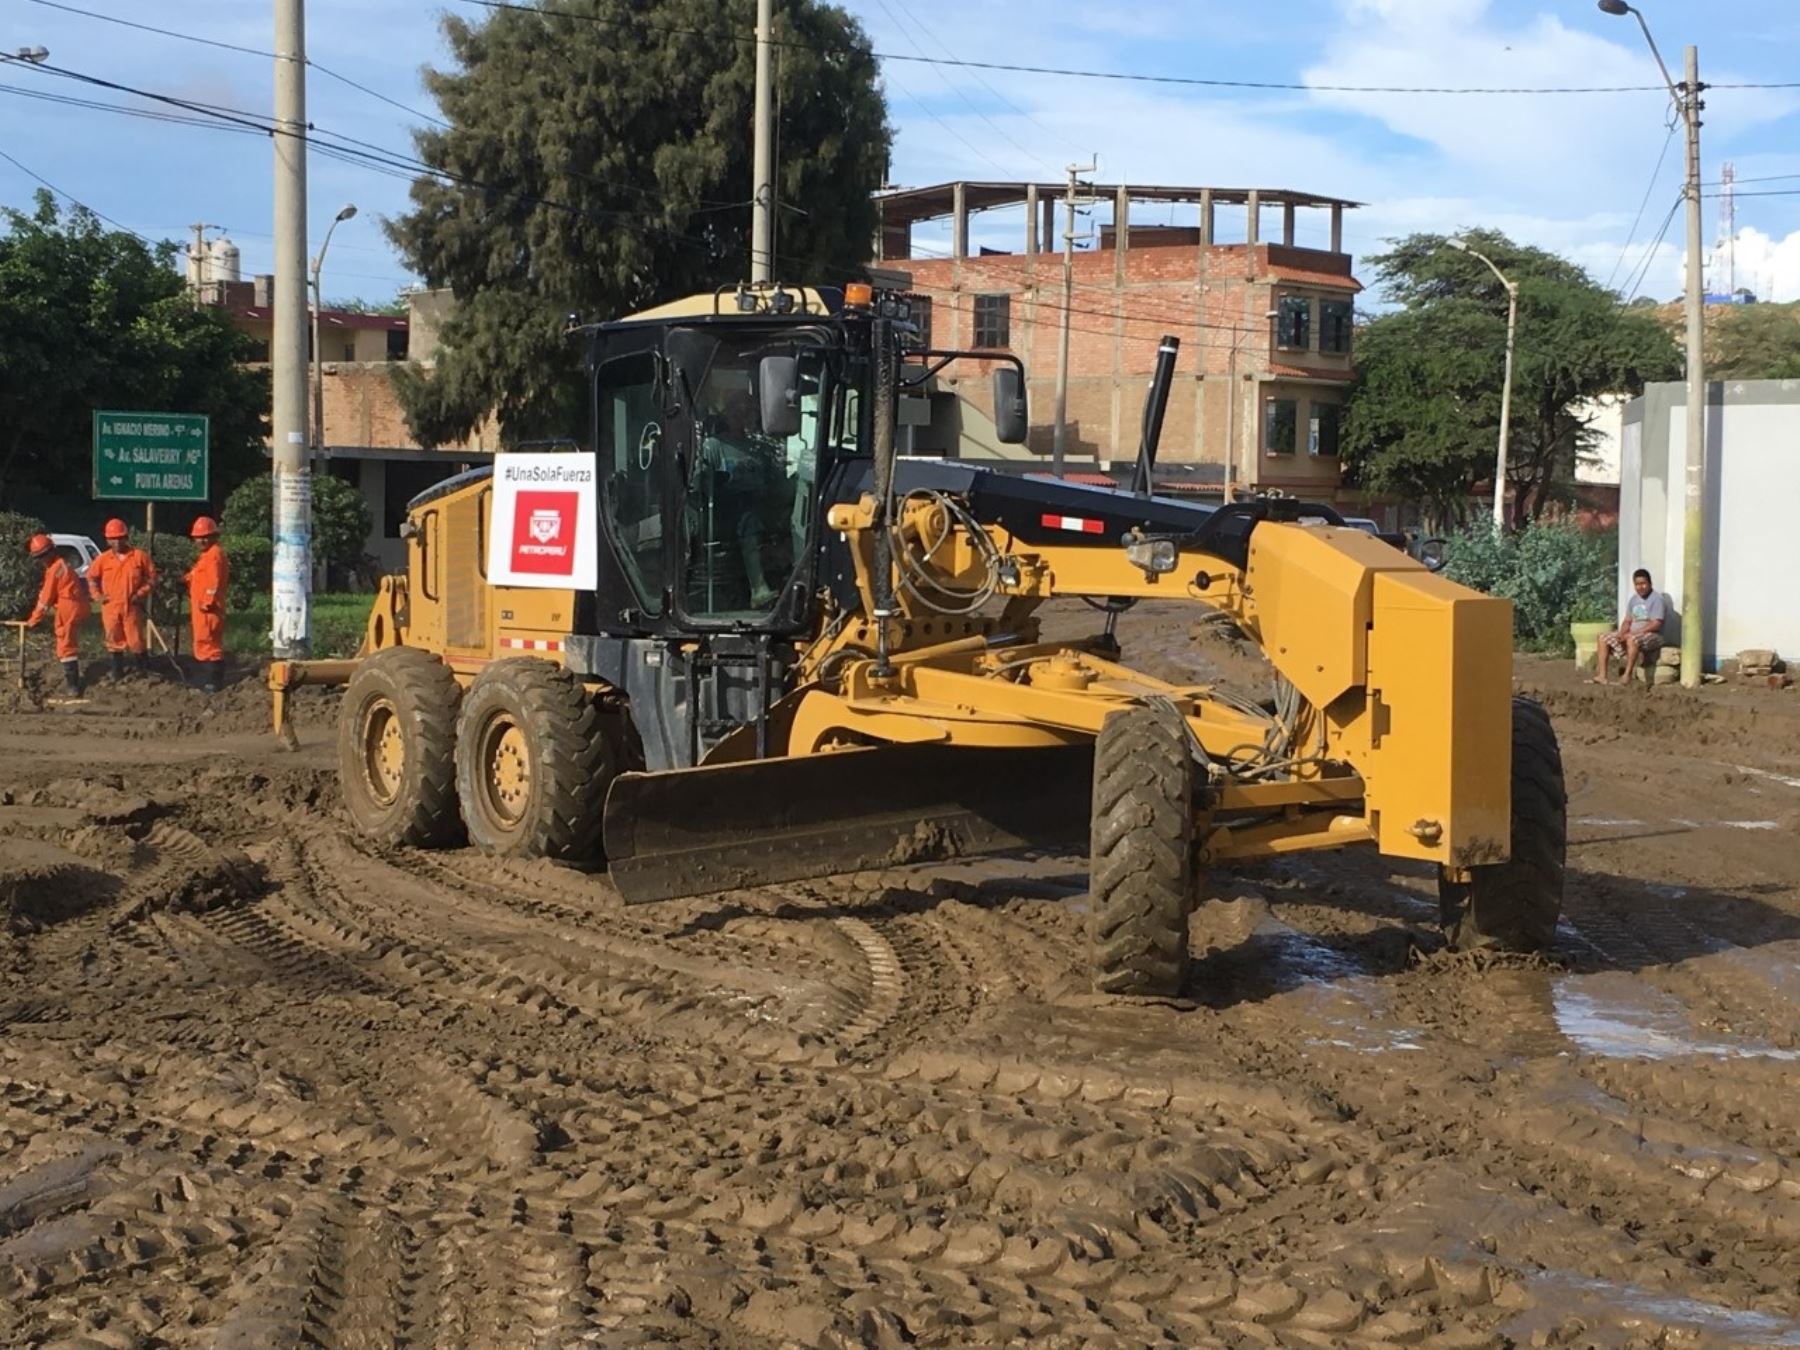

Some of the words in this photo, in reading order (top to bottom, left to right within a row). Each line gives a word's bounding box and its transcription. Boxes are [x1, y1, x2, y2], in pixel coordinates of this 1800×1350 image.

[132, 447, 182, 464] SALAVERRY
[135, 473, 161, 489] PUNTA
[162, 473, 193, 490] ARENAS
[505, 466, 591, 482] #UnaSolaFuerza
